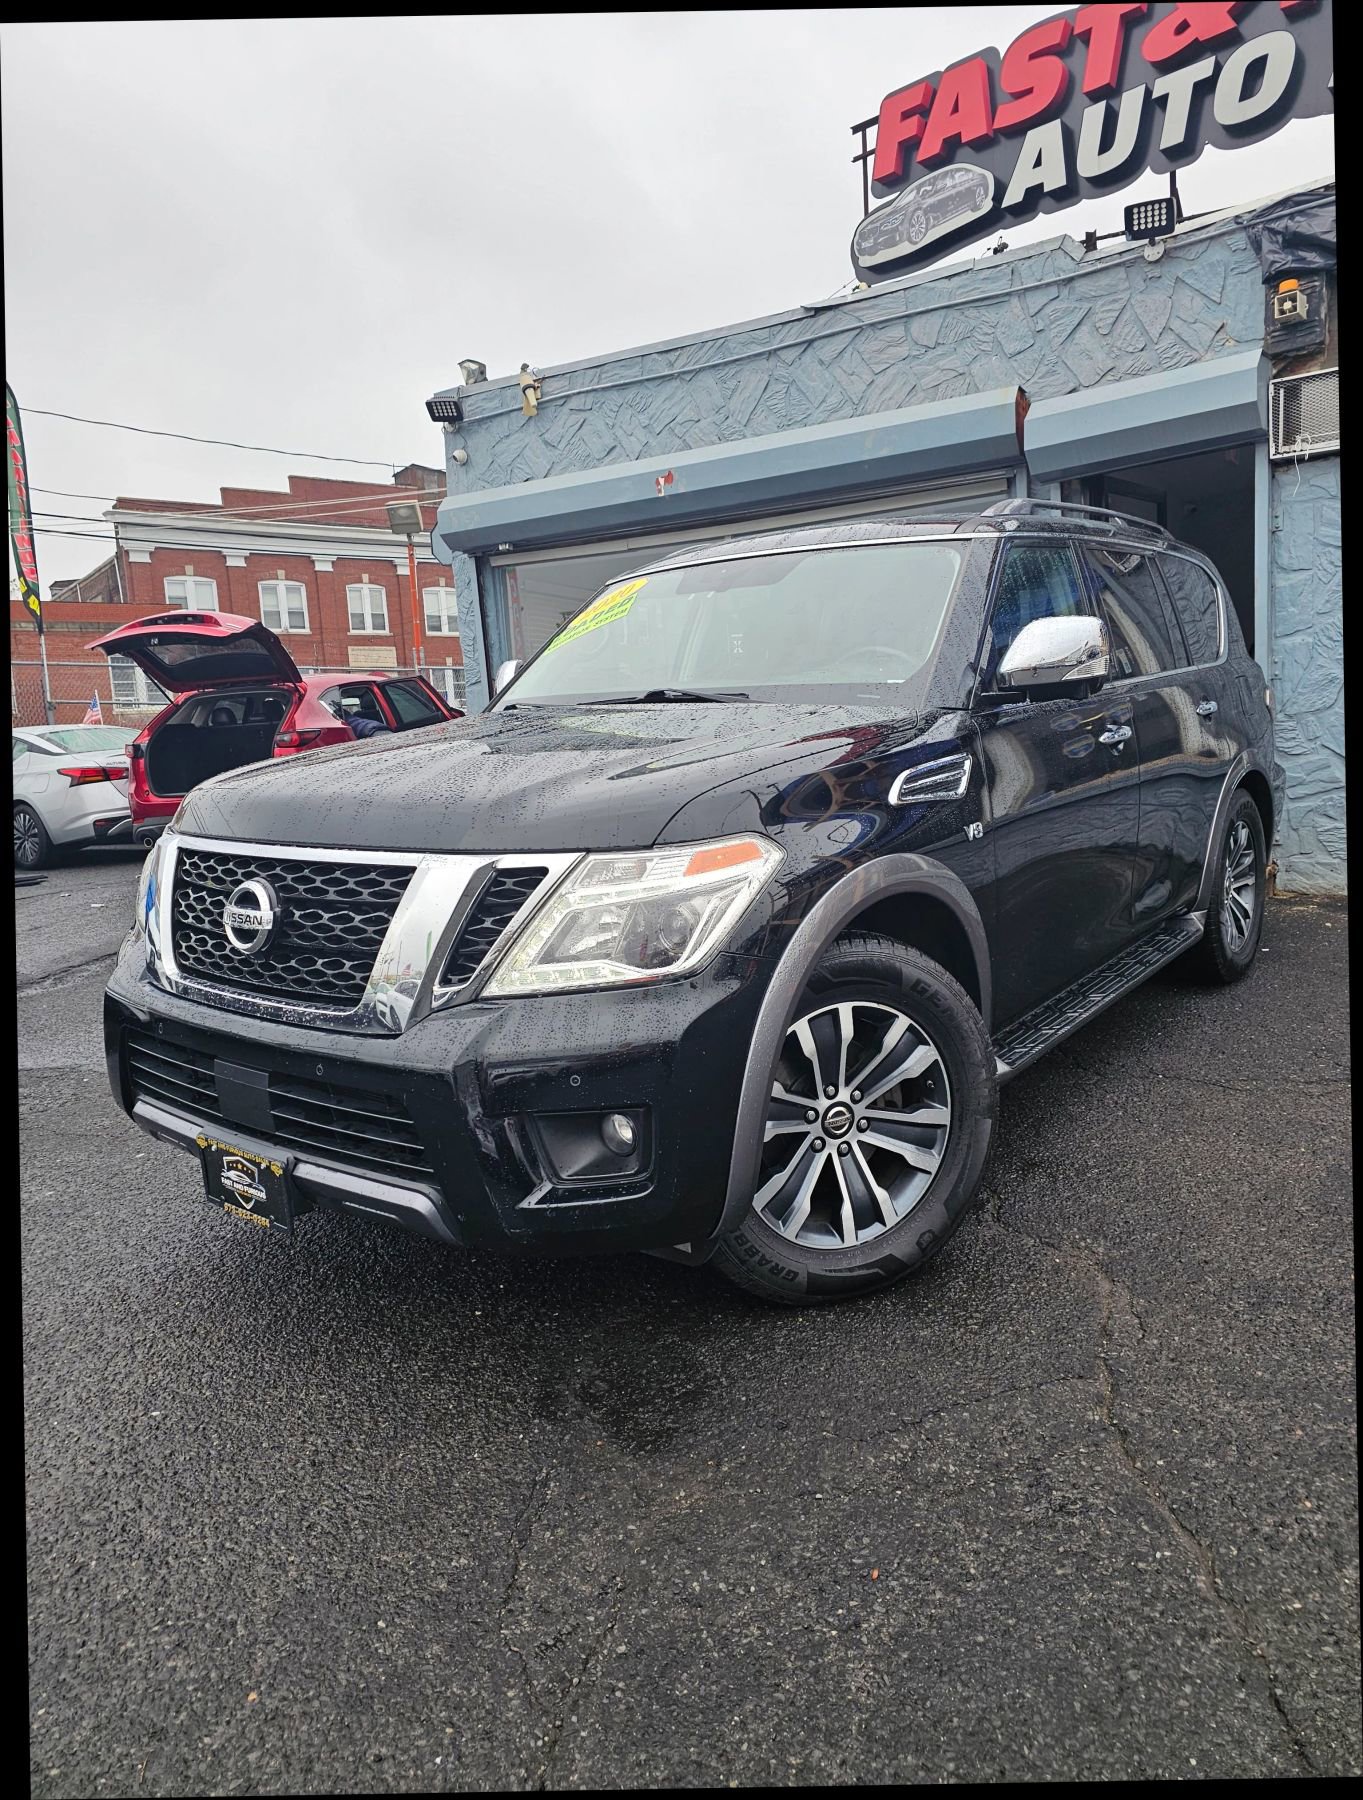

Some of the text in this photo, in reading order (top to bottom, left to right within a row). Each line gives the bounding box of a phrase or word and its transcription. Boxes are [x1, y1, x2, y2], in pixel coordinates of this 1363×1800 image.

[873, 3, 1148, 183] FAST
[1001, 30, 1297, 208] AUTO
[963, 822, 983, 841] V8
[734, 1233, 799, 1282] GRABB
